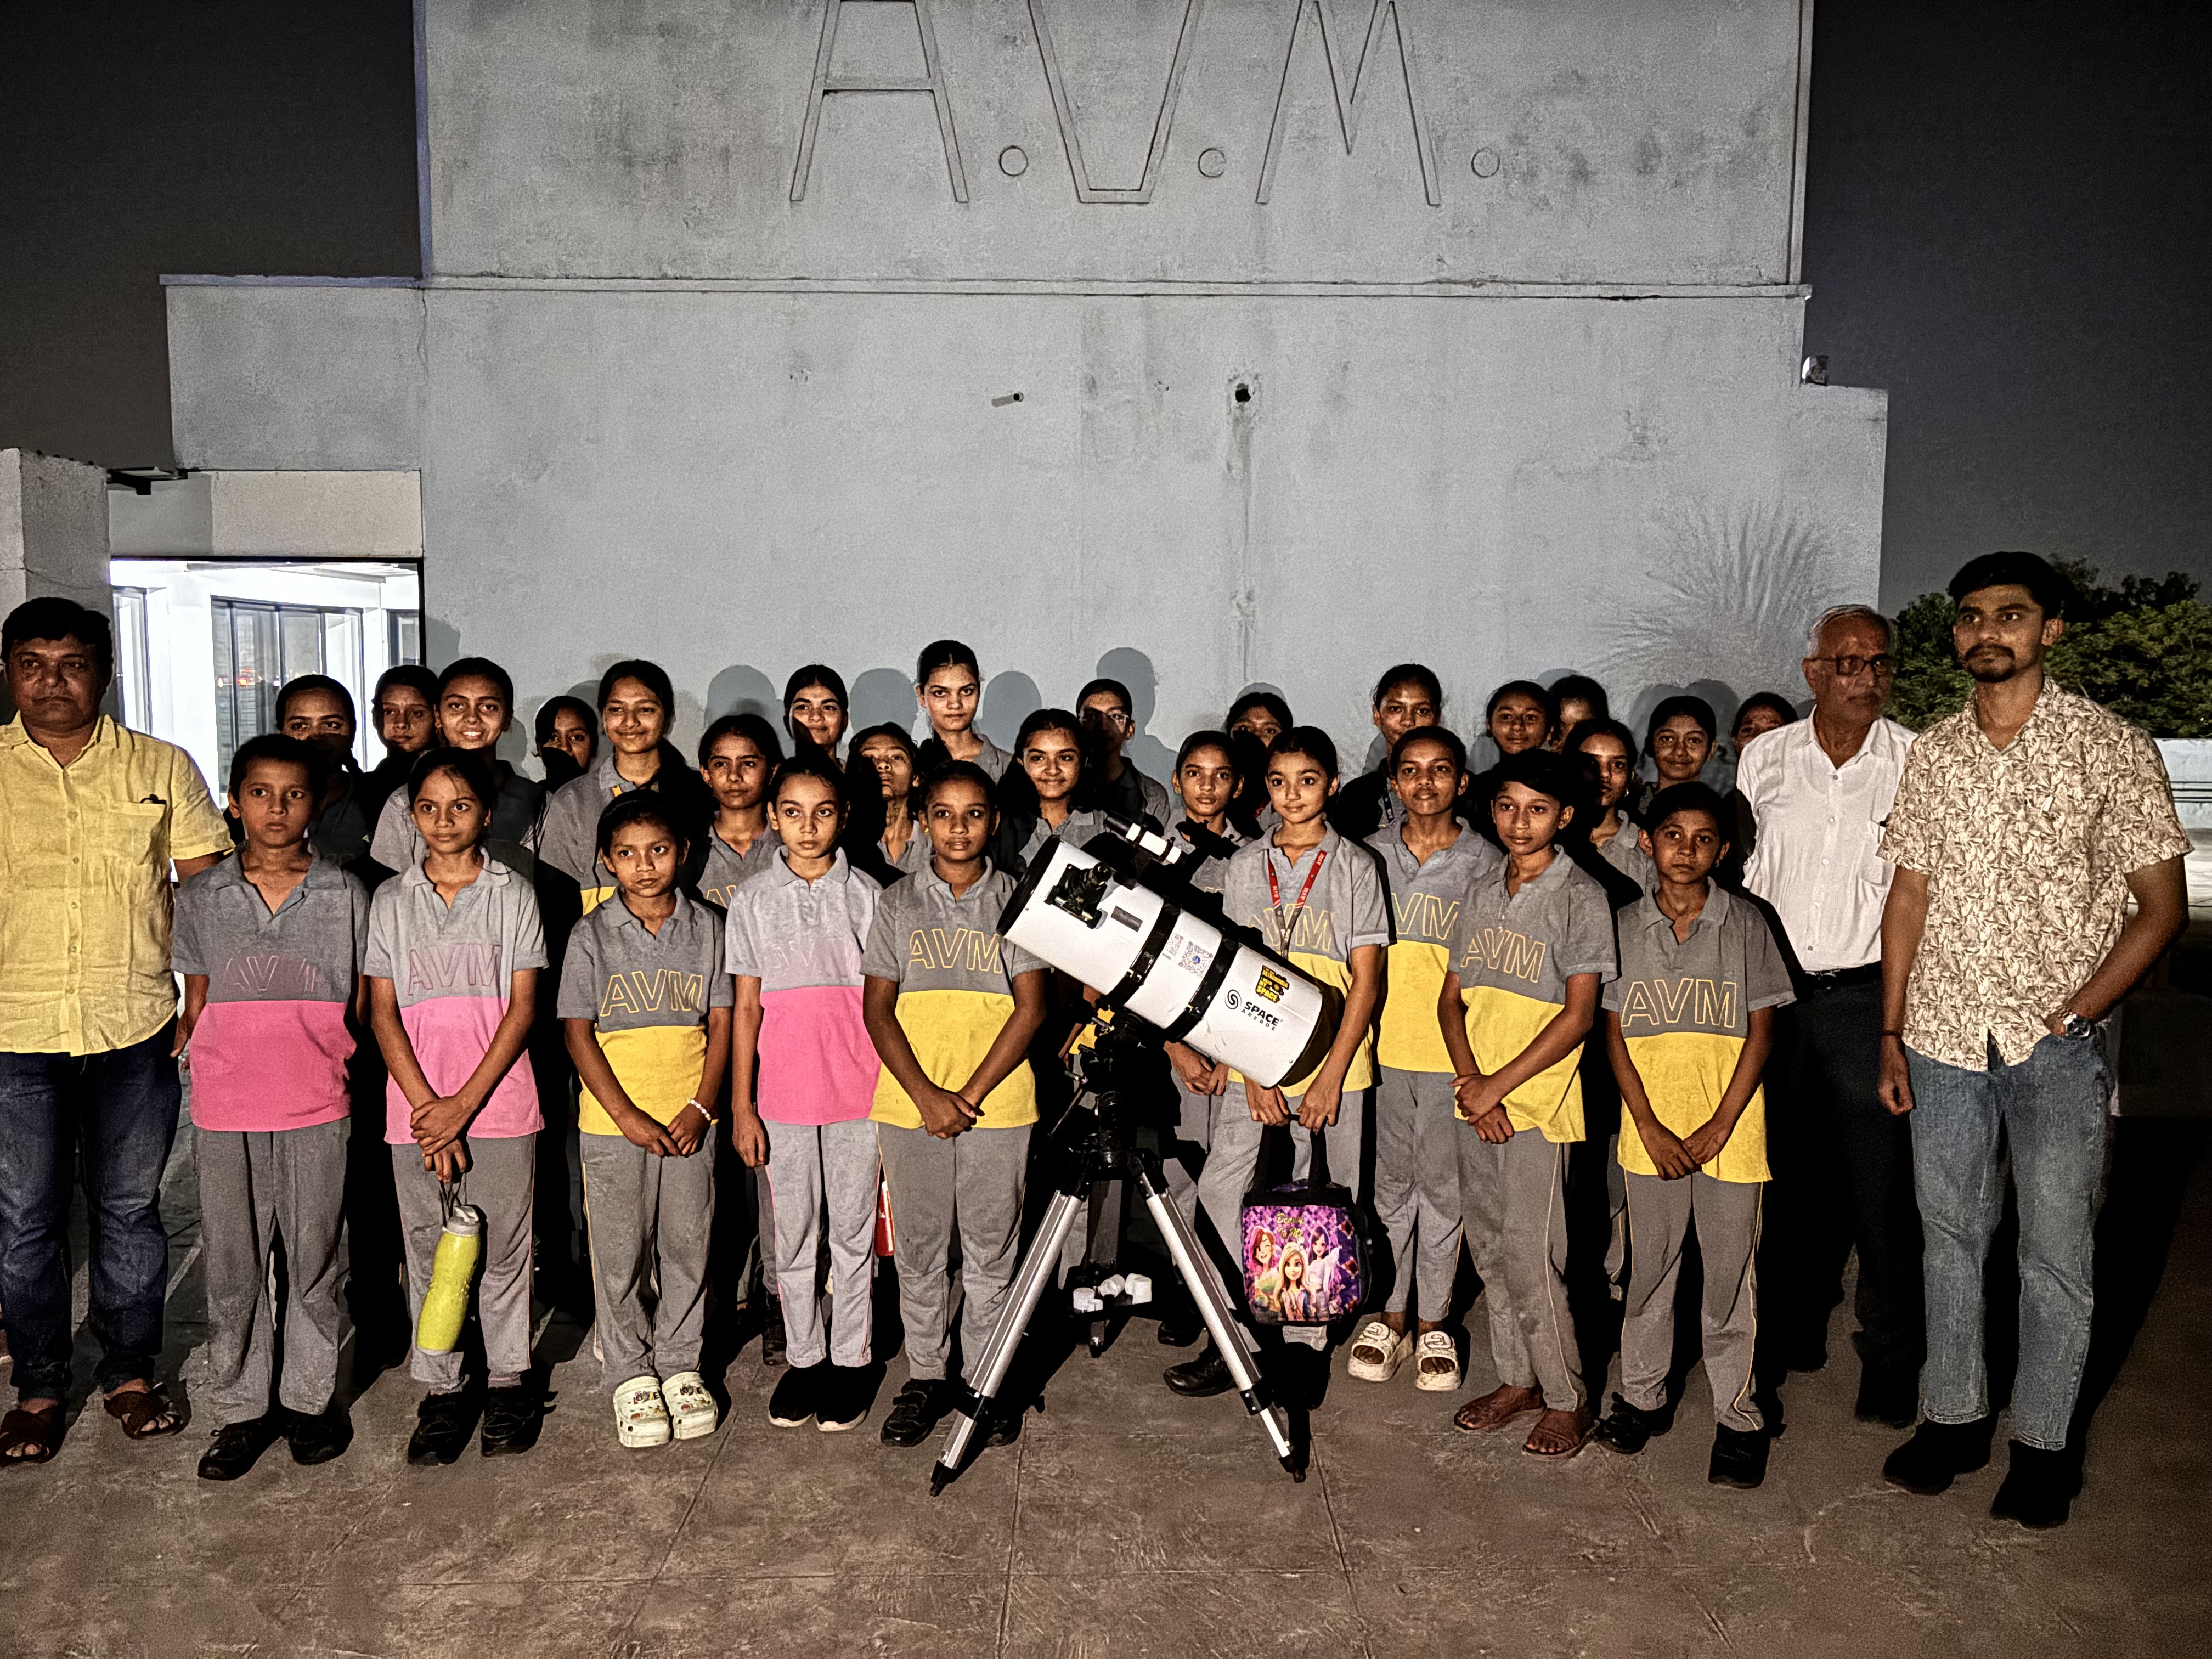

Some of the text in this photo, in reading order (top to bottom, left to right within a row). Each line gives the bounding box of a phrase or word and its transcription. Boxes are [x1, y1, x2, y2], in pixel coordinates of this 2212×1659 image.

[789, 0, 1500, 206] A.V.M.
[1391, 892, 1461, 940] VM
[407, 942, 503, 996] AVM
[907, 928, 1003, 974] AVM
[1460, 928, 1546, 983] AVM
[600, 969, 703, 1017] AVM
[1244, 1001, 1279, 1026] SPACE
[1256, 985, 1278, 1002] SPACE
[1621, 978, 1737, 1028] AVM
[1241, 1009, 1276, 1031] ARCADE
